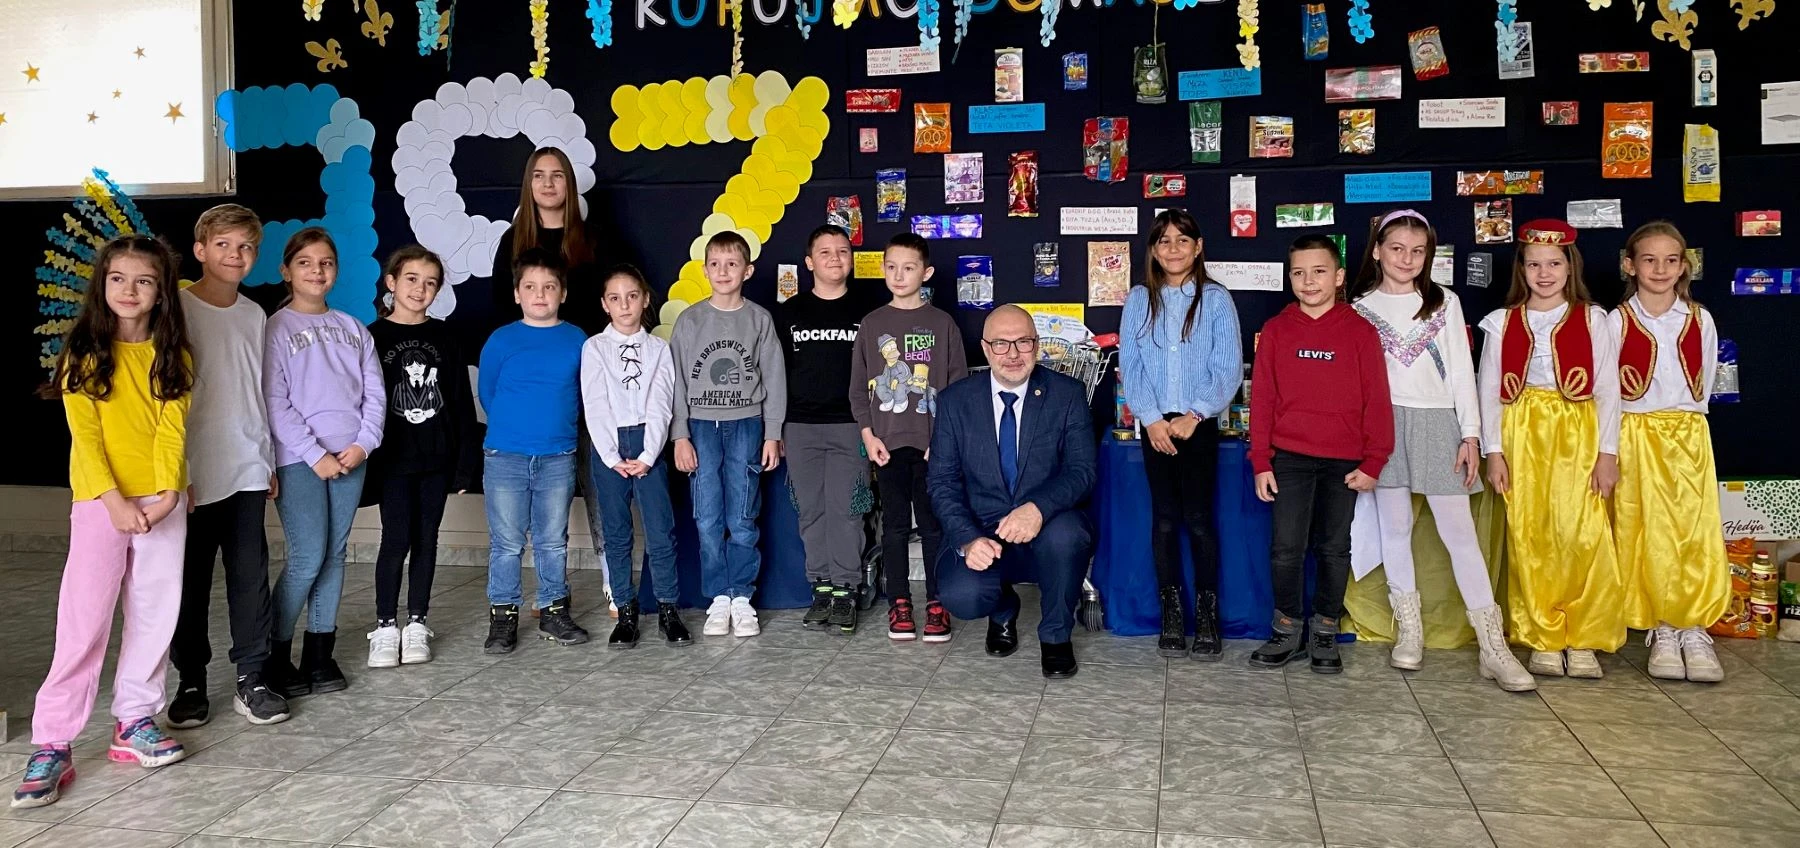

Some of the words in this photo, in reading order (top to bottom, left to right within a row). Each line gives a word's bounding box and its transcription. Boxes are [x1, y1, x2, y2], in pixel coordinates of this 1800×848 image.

[904, 334, 935, 353] FRESH
[383, 350, 396, 364] NO
[395, 340, 420, 352] HUG
[421, 341, 442, 363] ZONE
[691, 359, 703, 380] NEW
[700, 339, 747, 360] BRUNSWICK
[1298, 349, 1333, 360] LEVI'S
[690, 398, 728, 406] FOOTBALL
[702, 390, 742, 399] AMERICAN
